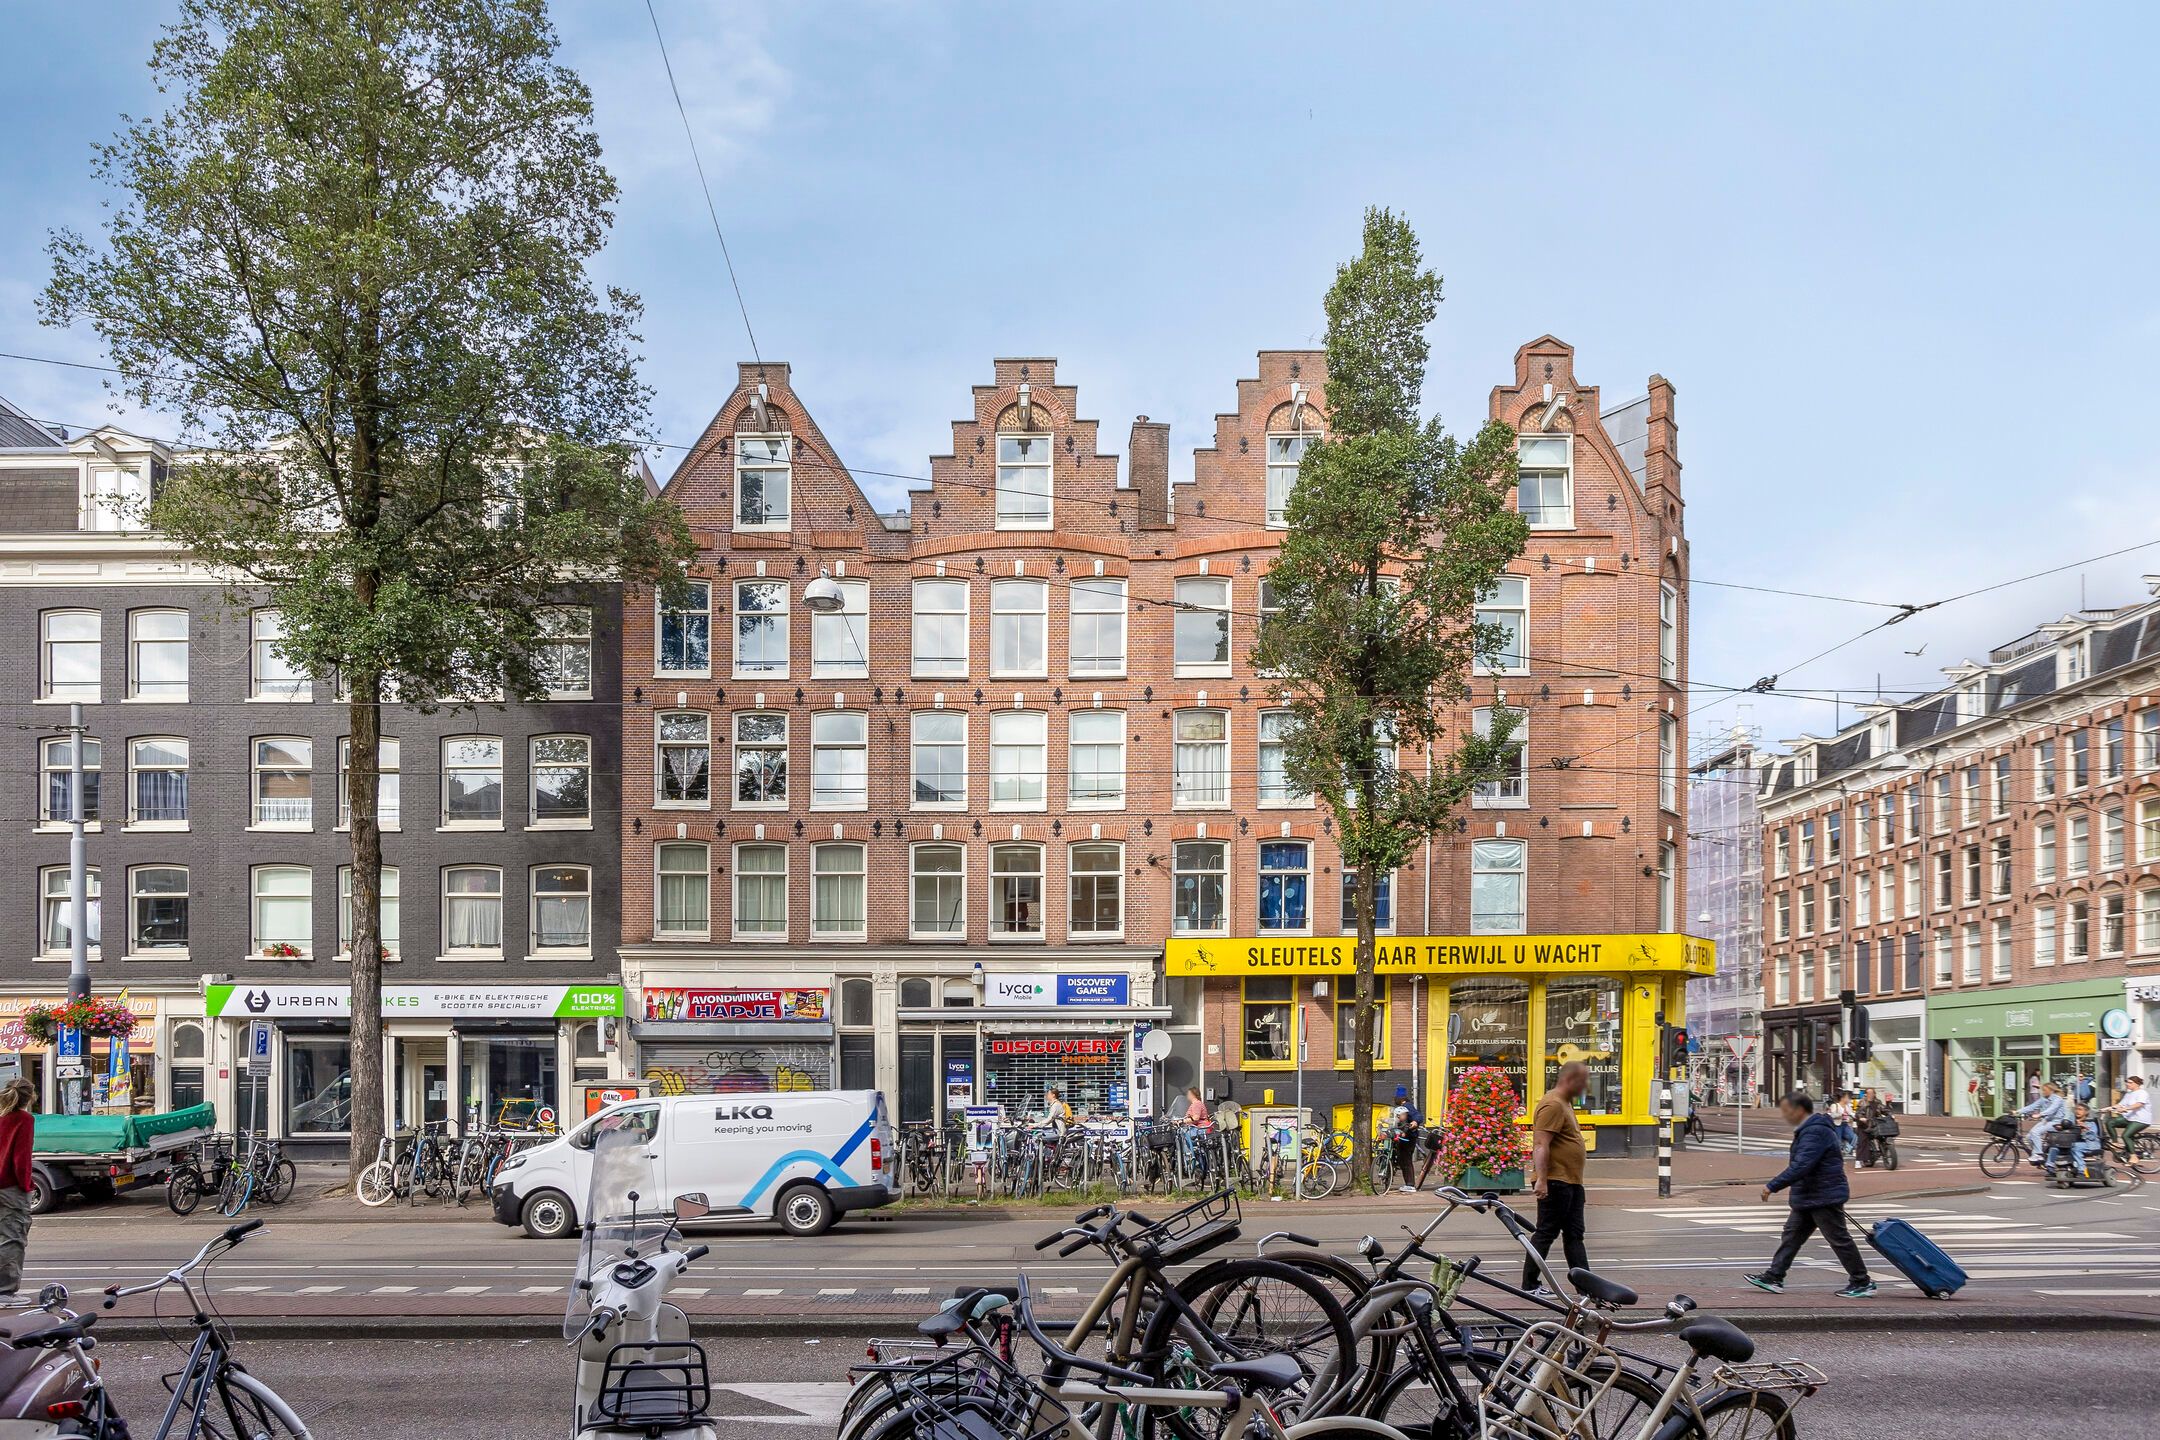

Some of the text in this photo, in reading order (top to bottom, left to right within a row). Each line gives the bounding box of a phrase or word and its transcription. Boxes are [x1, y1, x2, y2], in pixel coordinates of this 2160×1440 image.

[1247, 943, 1602, 967] SLEUTELS AAR TERWIJL U WACHT
[1685, 943, 1710, 967] SLOTEN
[1067, 978, 1117, 987] DISCOVERY
[999, 982, 1032, 997] Lyca
[1076, 987, 1108, 995] GAMES
[276, 996, 338, 1007] URBAN
[572, 993, 616, 1004] 100%
[691, 991, 777, 1005] AVONDWINKEL
[694, 1005, 776, 1018] HAPJE
[10, 1035, 24, 1047] 28
[258, 1031, 266, 1045] P
[991, 1039, 1125, 1054] DISCOVERY
[948, 1062, 965, 1070] Lyca
[1061, 1055, 1110, 1066] PHONES
[1453, 1066, 1466, 1075] DE
[1545, 1065, 1558, 1074] DE
[589, 1091, 599, 1099] WE
[602, 1093, 621, 1102] DANCE
[715, 1104, 775, 1120] LKQ
[714, 1122, 813, 1135] Keeping you moving
